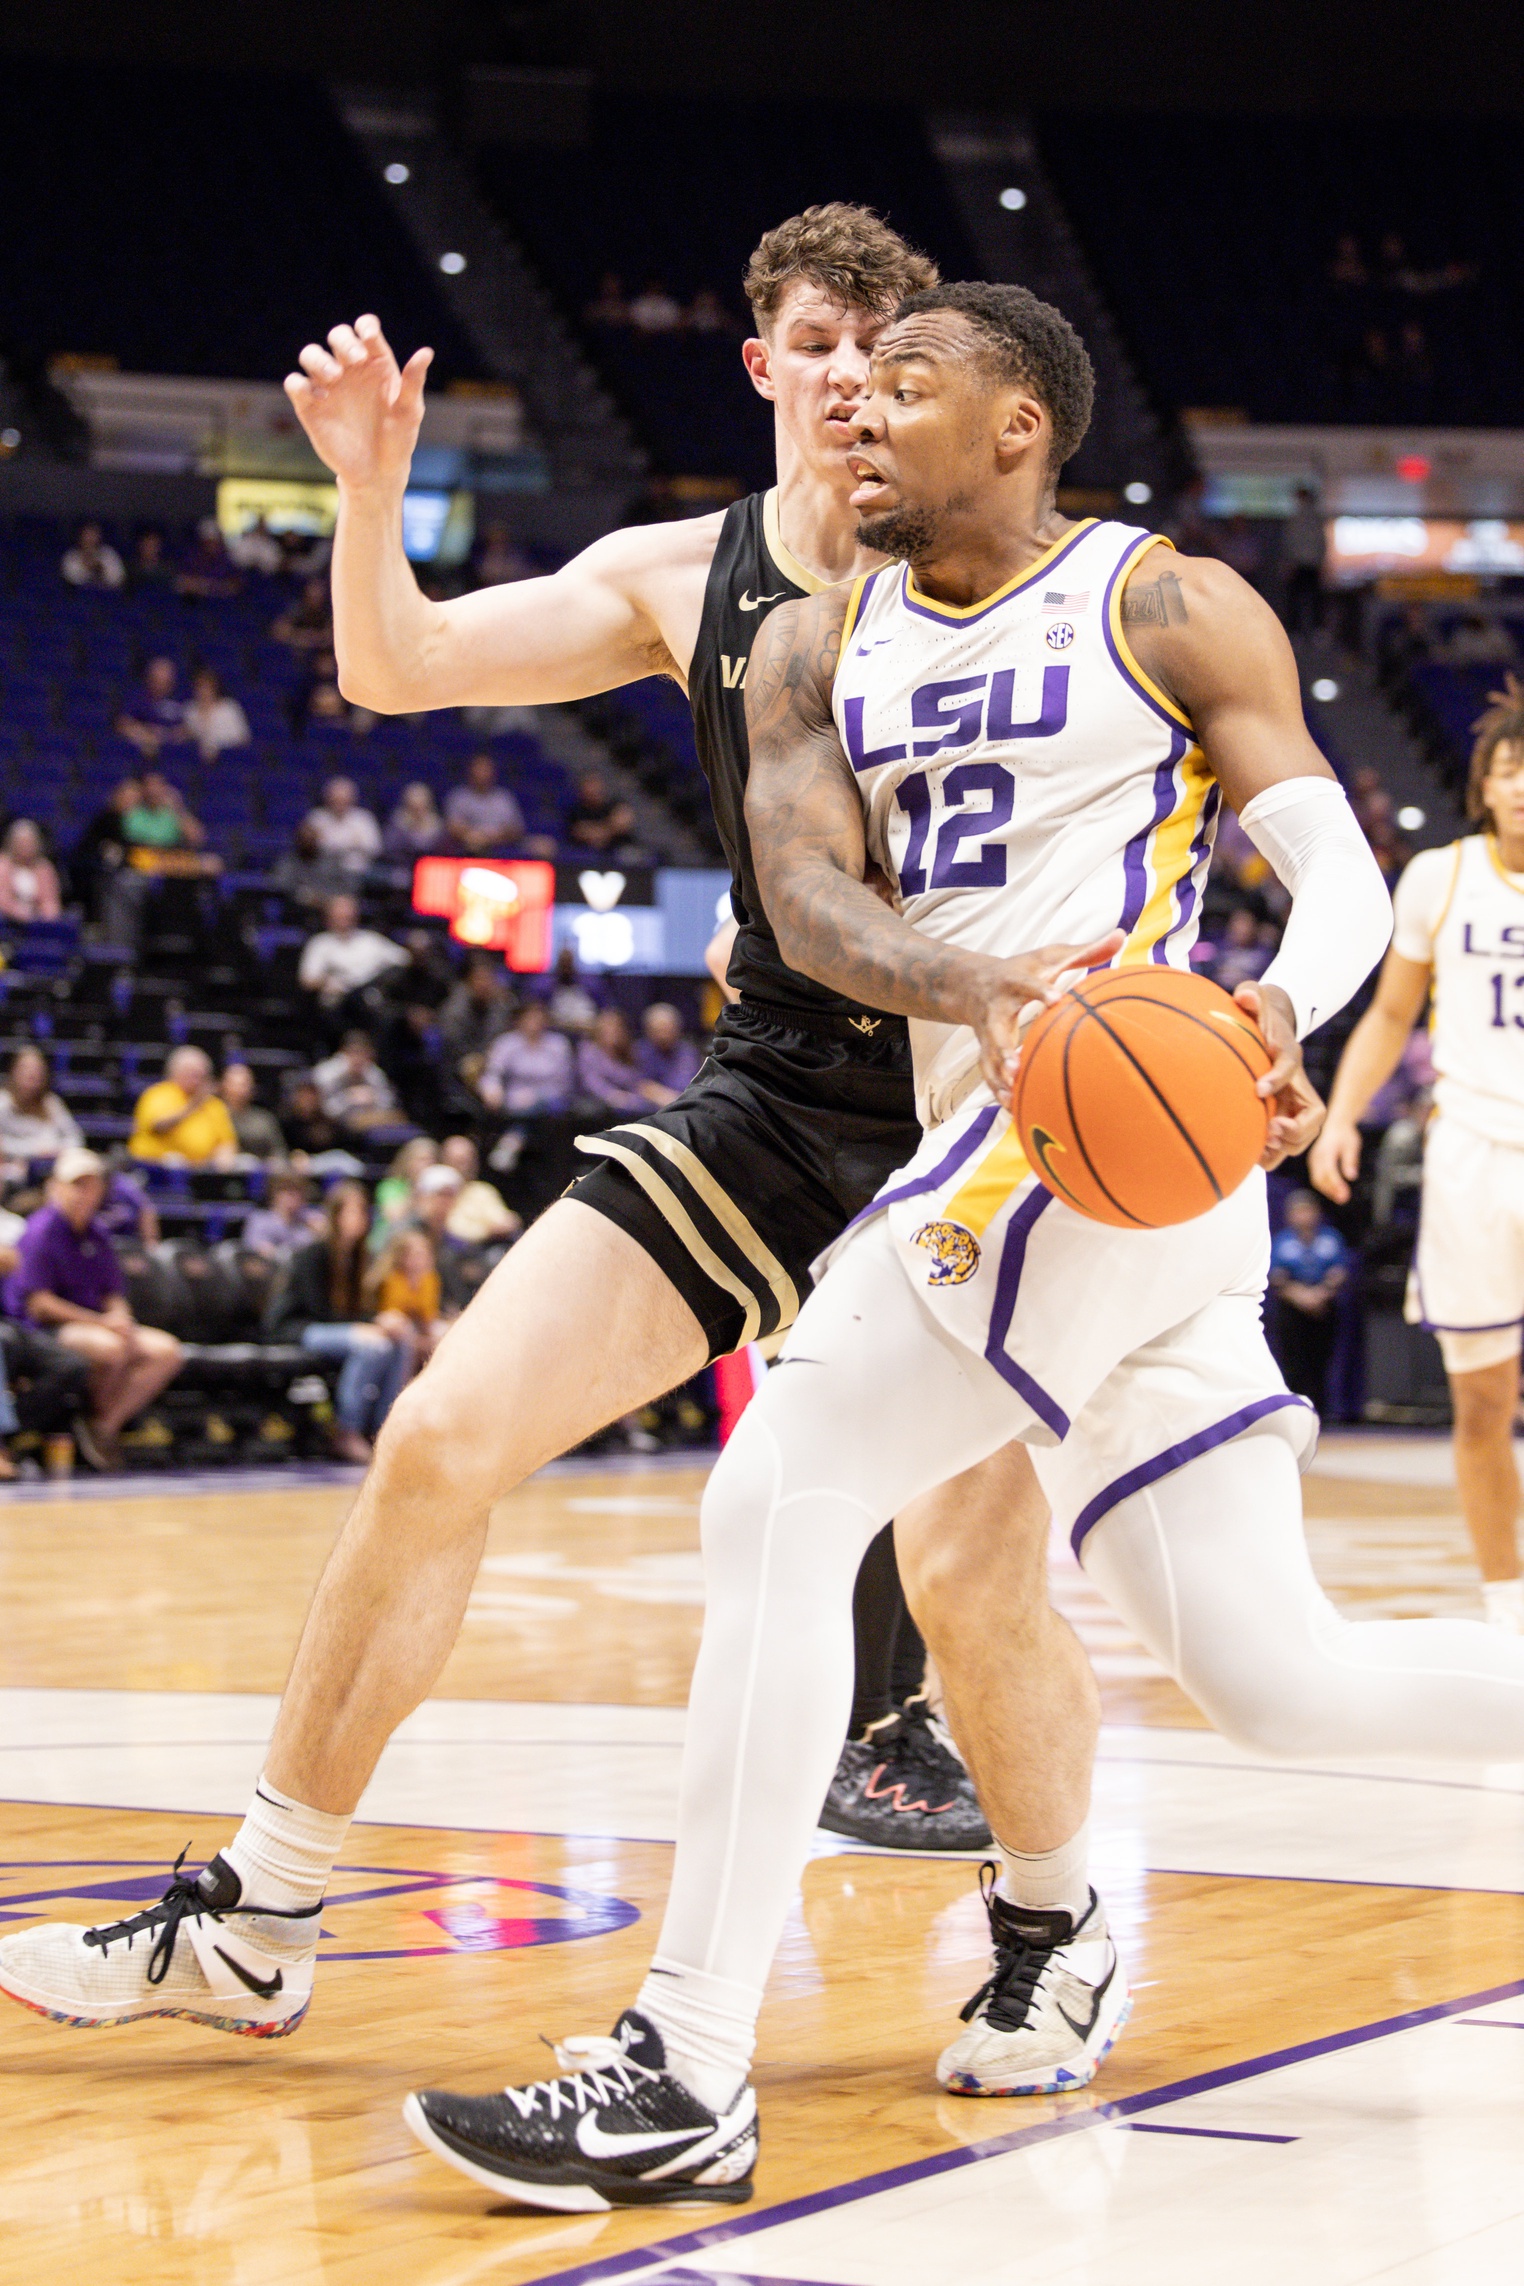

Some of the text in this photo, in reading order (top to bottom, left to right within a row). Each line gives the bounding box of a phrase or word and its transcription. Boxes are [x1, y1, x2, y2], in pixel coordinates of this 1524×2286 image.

[1046, 622, 1074, 649] SEC
[721, 655, 748, 689] V
[844, 665, 1071, 773] LSU
[895, 763, 1015, 898] 12
